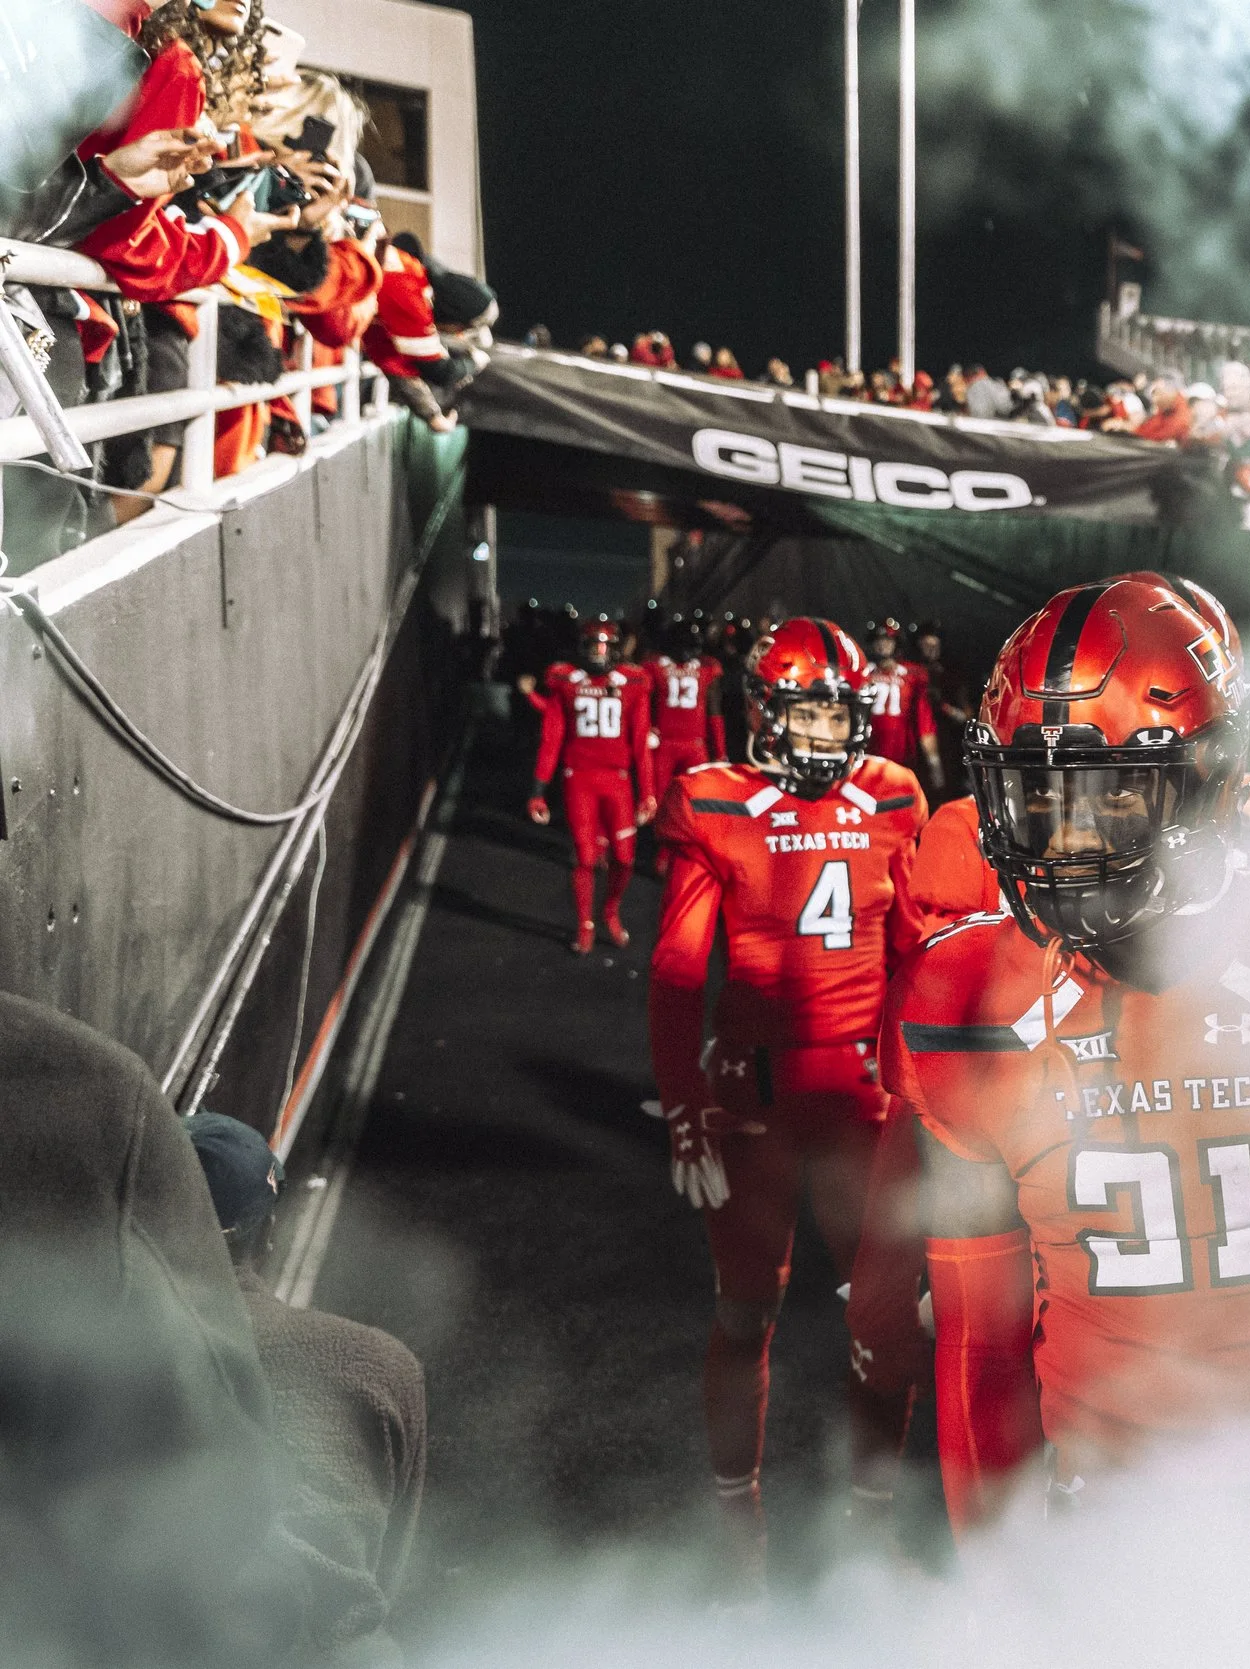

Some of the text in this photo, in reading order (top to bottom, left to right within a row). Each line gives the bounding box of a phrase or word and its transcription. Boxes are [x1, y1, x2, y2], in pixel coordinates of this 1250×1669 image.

[667, 676, 699, 709] 13
[574, 696, 622, 738] 20
[765, 832, 870, 853] TEXAS TECH
[797, 859, 854, 950] 4
